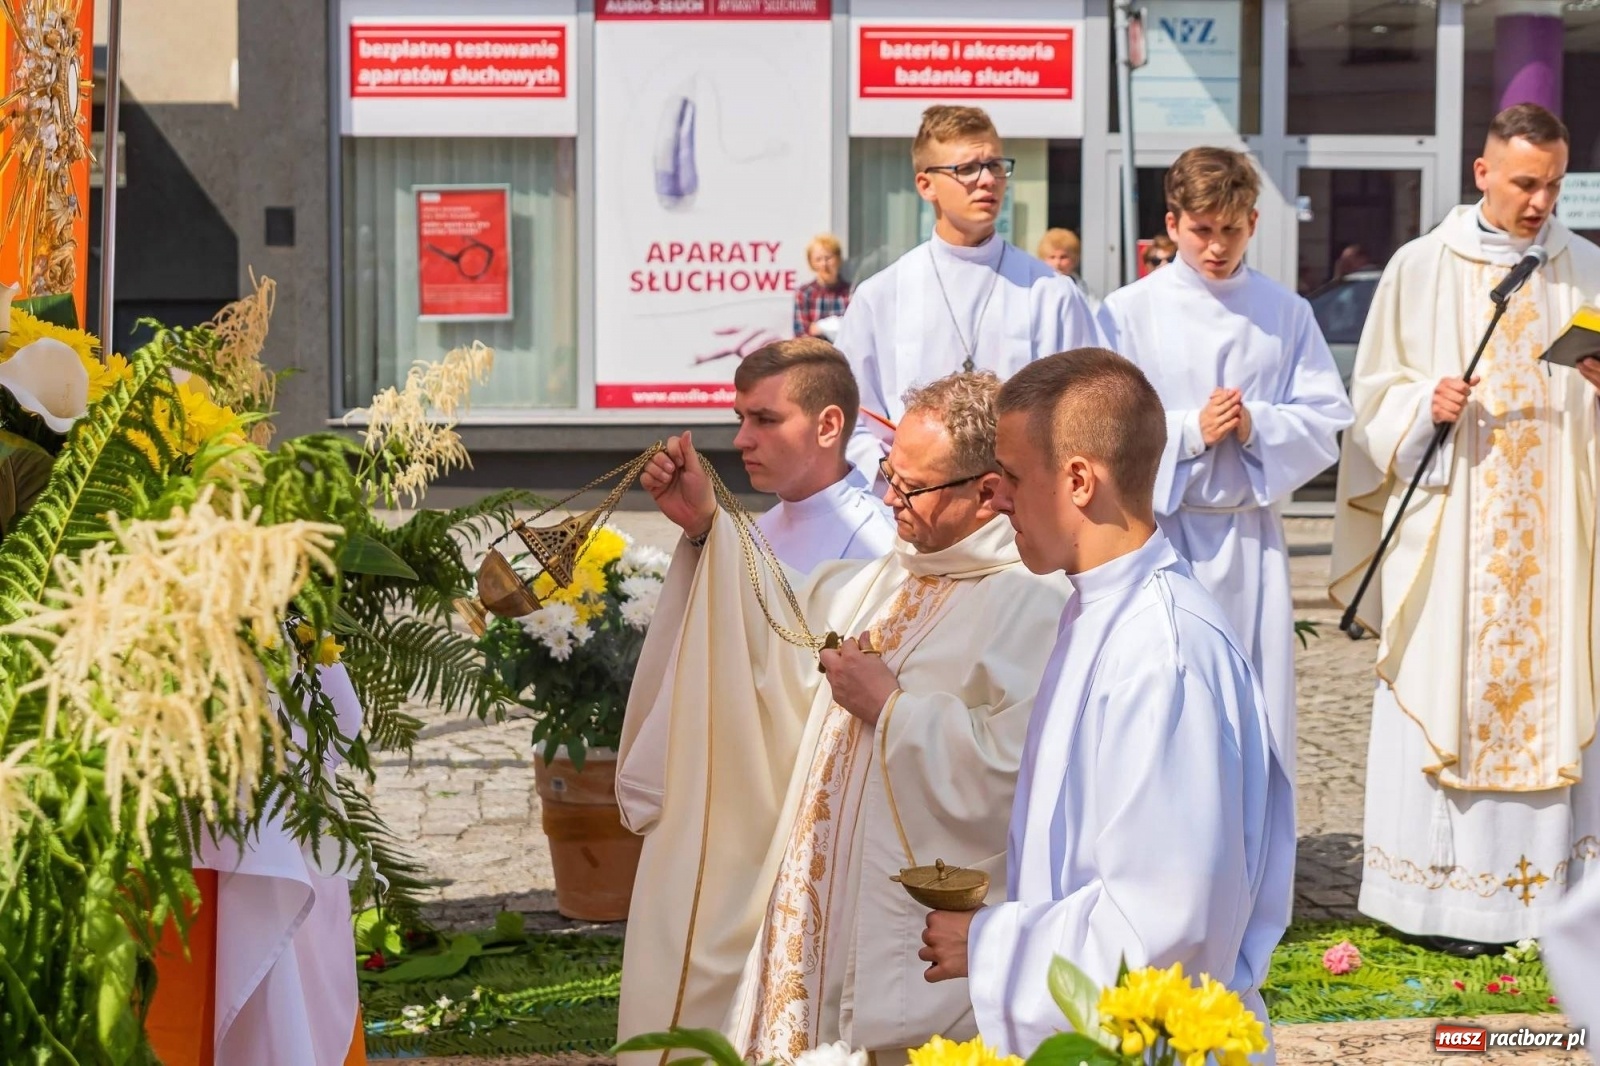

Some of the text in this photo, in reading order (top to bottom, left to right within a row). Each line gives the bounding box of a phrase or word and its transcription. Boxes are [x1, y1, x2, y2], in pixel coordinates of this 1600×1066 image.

[1158, 17, 1217, 44] NFZ
[455, 39, 559, 59] testowanie
[880, 40, 1054, 60] baterie i akcesoria
[358, 65, 448, 88] aparatów
[895, 65, 973, 86] badanie
[646, 241, 781, 263] APARATY
[630, 270, 797, 292] SŁUCHOWE
[632, 388, 736, 403] www.audio-slu
